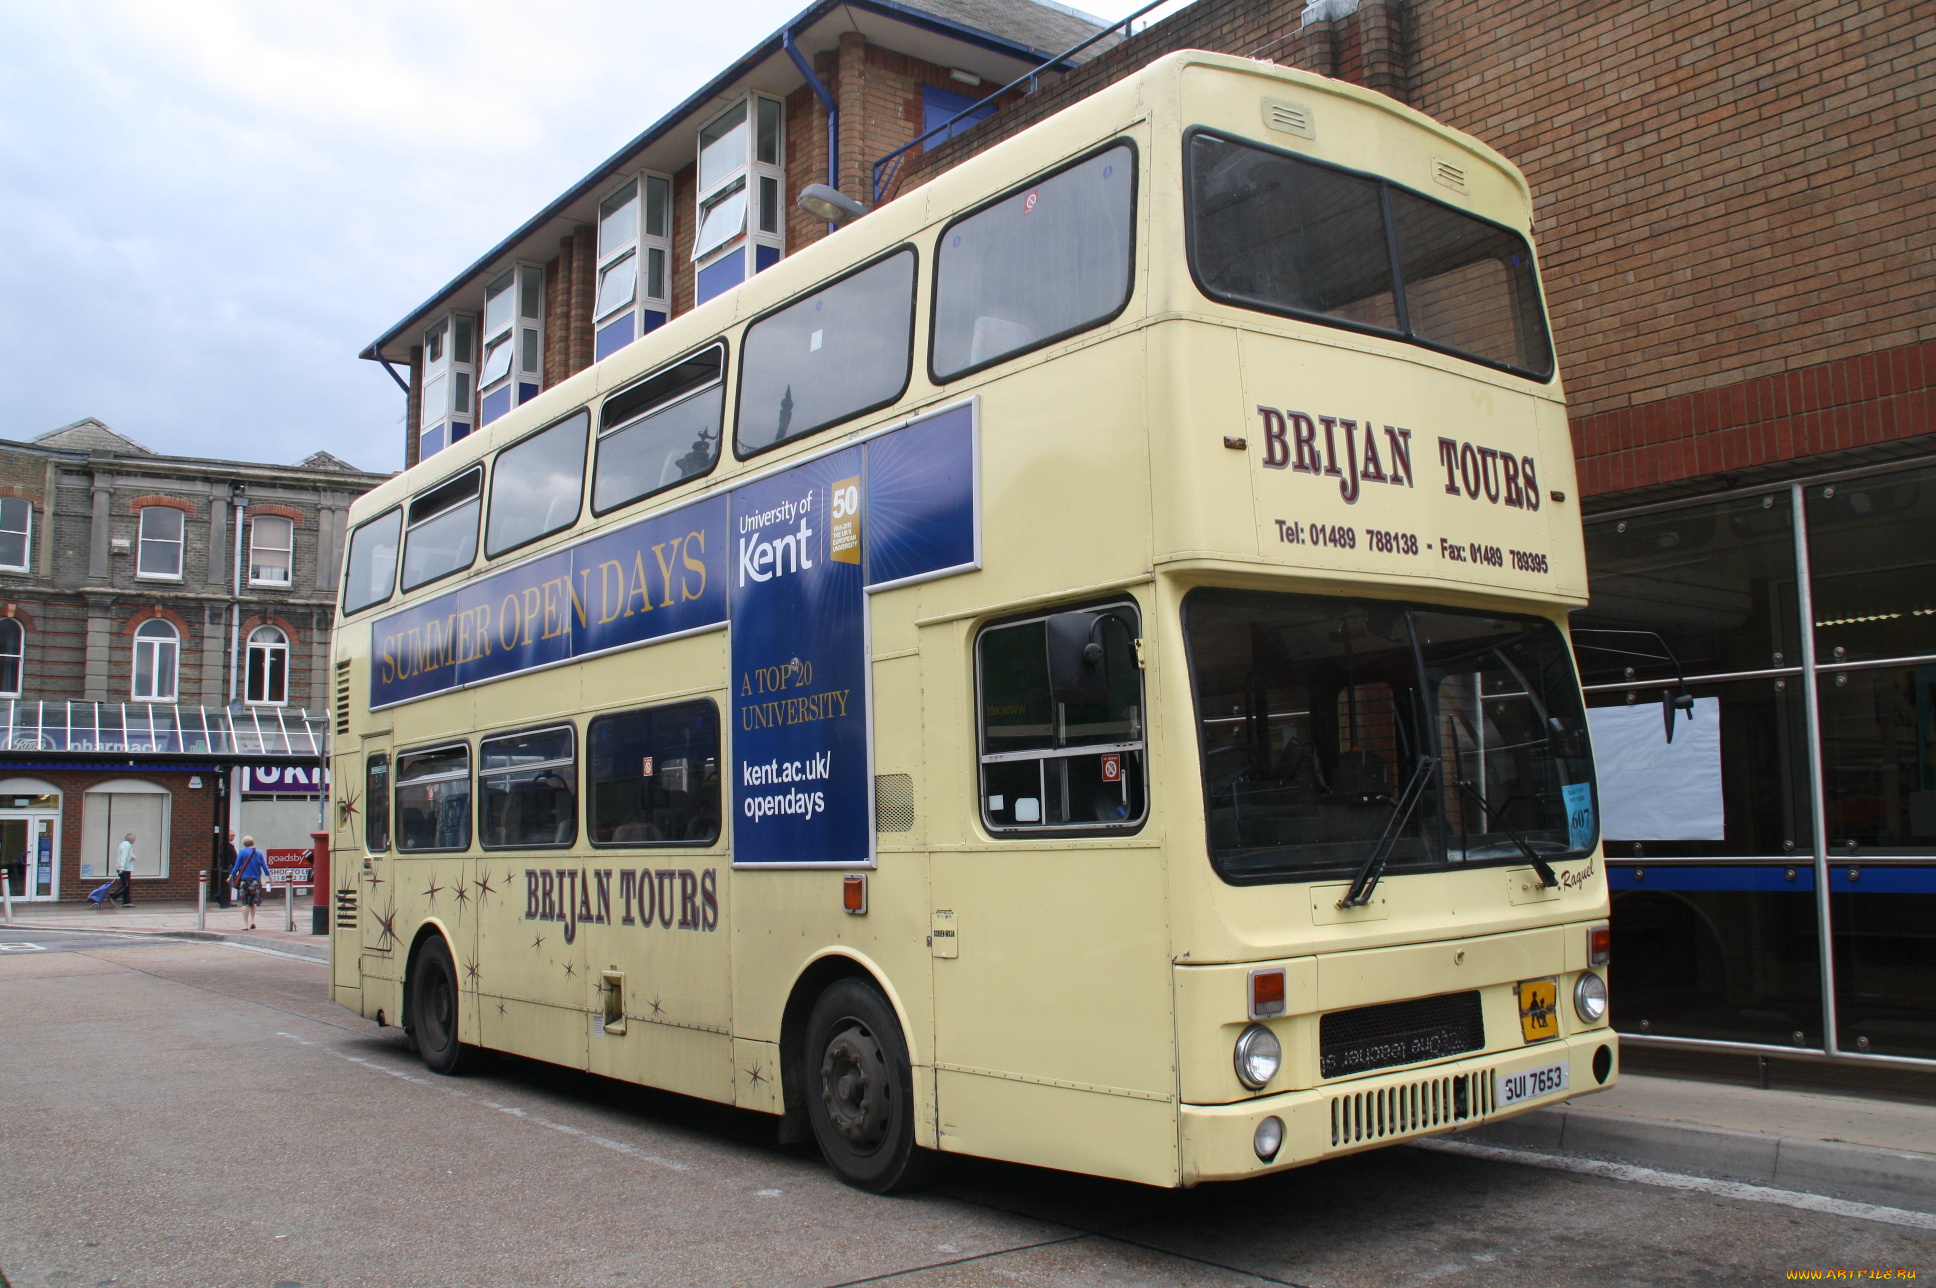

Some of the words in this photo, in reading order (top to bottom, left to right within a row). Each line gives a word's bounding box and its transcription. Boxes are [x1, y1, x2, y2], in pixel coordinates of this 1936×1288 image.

[1257, 404, 1414, 505] BRIJAN
[1438, 436, 1540, 512] TOURS
[740, 500, 797, 534] University
[799, 490, 813, 514] of
[832, 486, 858, 518] 50
[740, 517, 812, 587] Kent
[832, 541, 858, 552] UNIVERSITY
[833, 531, 841, 539] THE
[833, 534, 857, 545] EUROPEAN
[1274, 519, 1306, 545] Tel:
[1309, 522, 1356, 550] 01489
[1366, 529, 1419, 555] 788138
[1440, 537, 1467, 562] Fax:
[1469, 542, 1503, 568] 01489
[1509, 549, 1548, 574] 789395
[382, 604, 492, 684] SUMMER
[500, 568, 590, 651] OPEN
[598, 529, 707, 625] DAYS
[741, 672, 753, 696] A
[755, 664, 792, 693] TOP
[795, 661, 813, 687] 20
[742, 689, 850, 731] UNIVERSITY
[743, 750, 831, 786] kent.ac.uk/
[744, 787, 825, 823] opendays
[1572, 808, 1590, 830] 607
[268, 853, 305, 865] goadsby
[1561, 857, 1594, 892] Raquel
[525, 867, 613, 945] BRIJAN
[619, 867, 719, 932] TOURS
[1505, 1074, 1526, 1101] SUI
[1529, 1066, 1562, 1095] 7653
